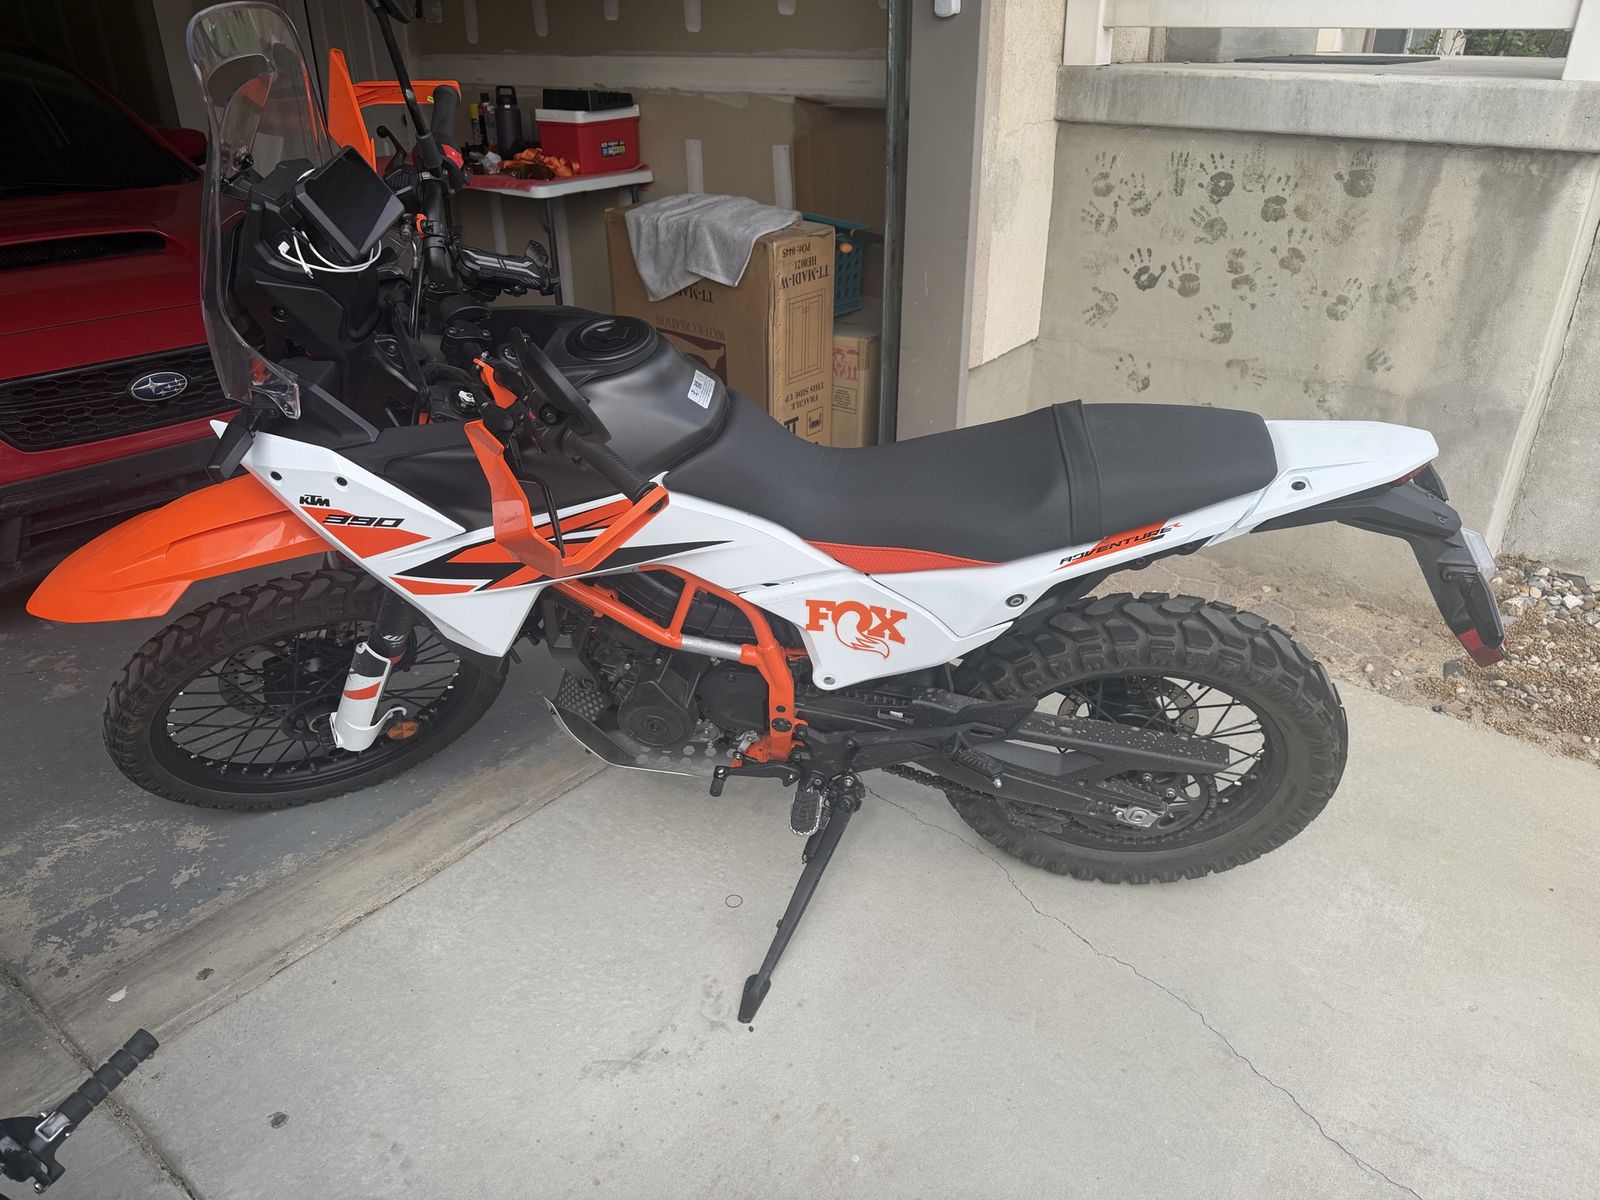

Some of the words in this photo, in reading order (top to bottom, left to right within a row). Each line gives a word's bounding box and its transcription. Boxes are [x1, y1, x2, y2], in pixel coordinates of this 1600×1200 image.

[779, 264, 830, 290] TT-MADI-W
[698, 325, 727, 341] WATER
[794, 387, 809, 399] SIDE
[809, 381, 825, 393] THIS
[784, 392, 794, 403] UP
[790, 393, 819, 411] FRAGILE
[299, 494, 331, 507] KTM
[322, 513, 405, 528] 390
[1059, 525, 1173, 565] ADVENTURE
[805, 599, 908, 659] FOX
